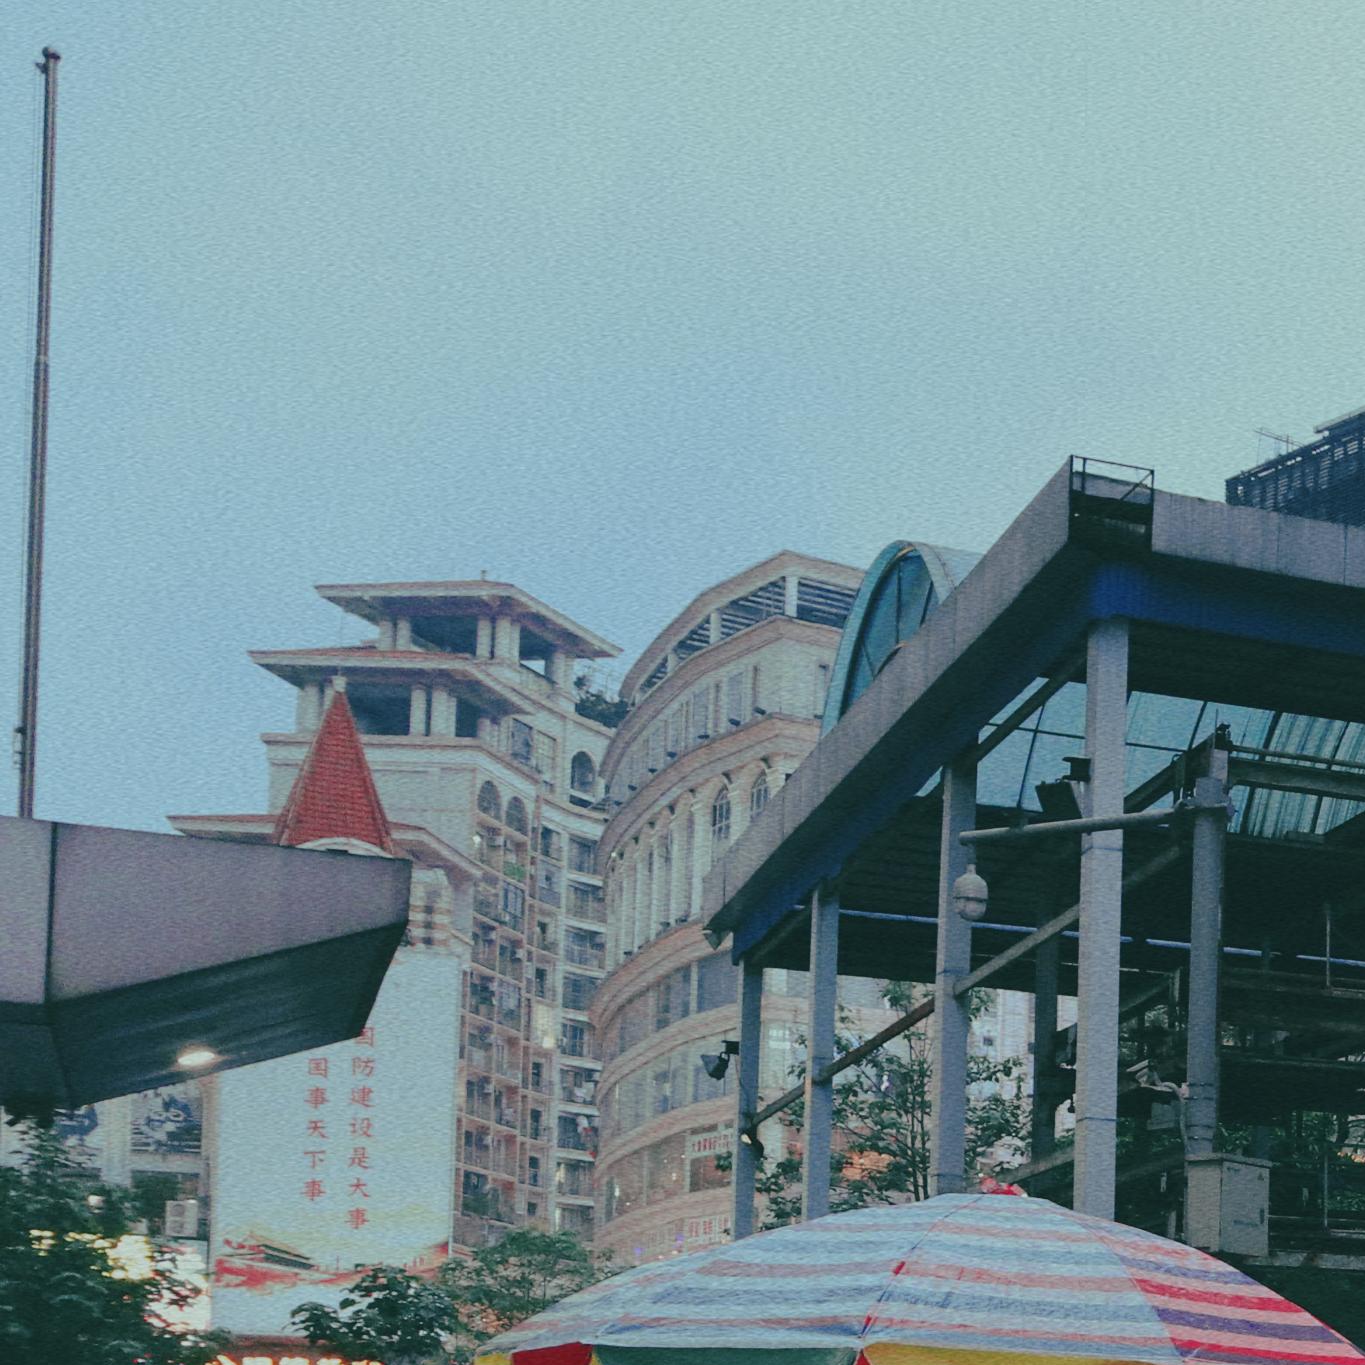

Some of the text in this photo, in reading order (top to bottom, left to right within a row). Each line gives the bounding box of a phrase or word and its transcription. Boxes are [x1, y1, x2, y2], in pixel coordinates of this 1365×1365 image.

[304, 1057, 330, 1201] 国事天下事
[345, 1026, 376, 1230] 国防建设是大事
